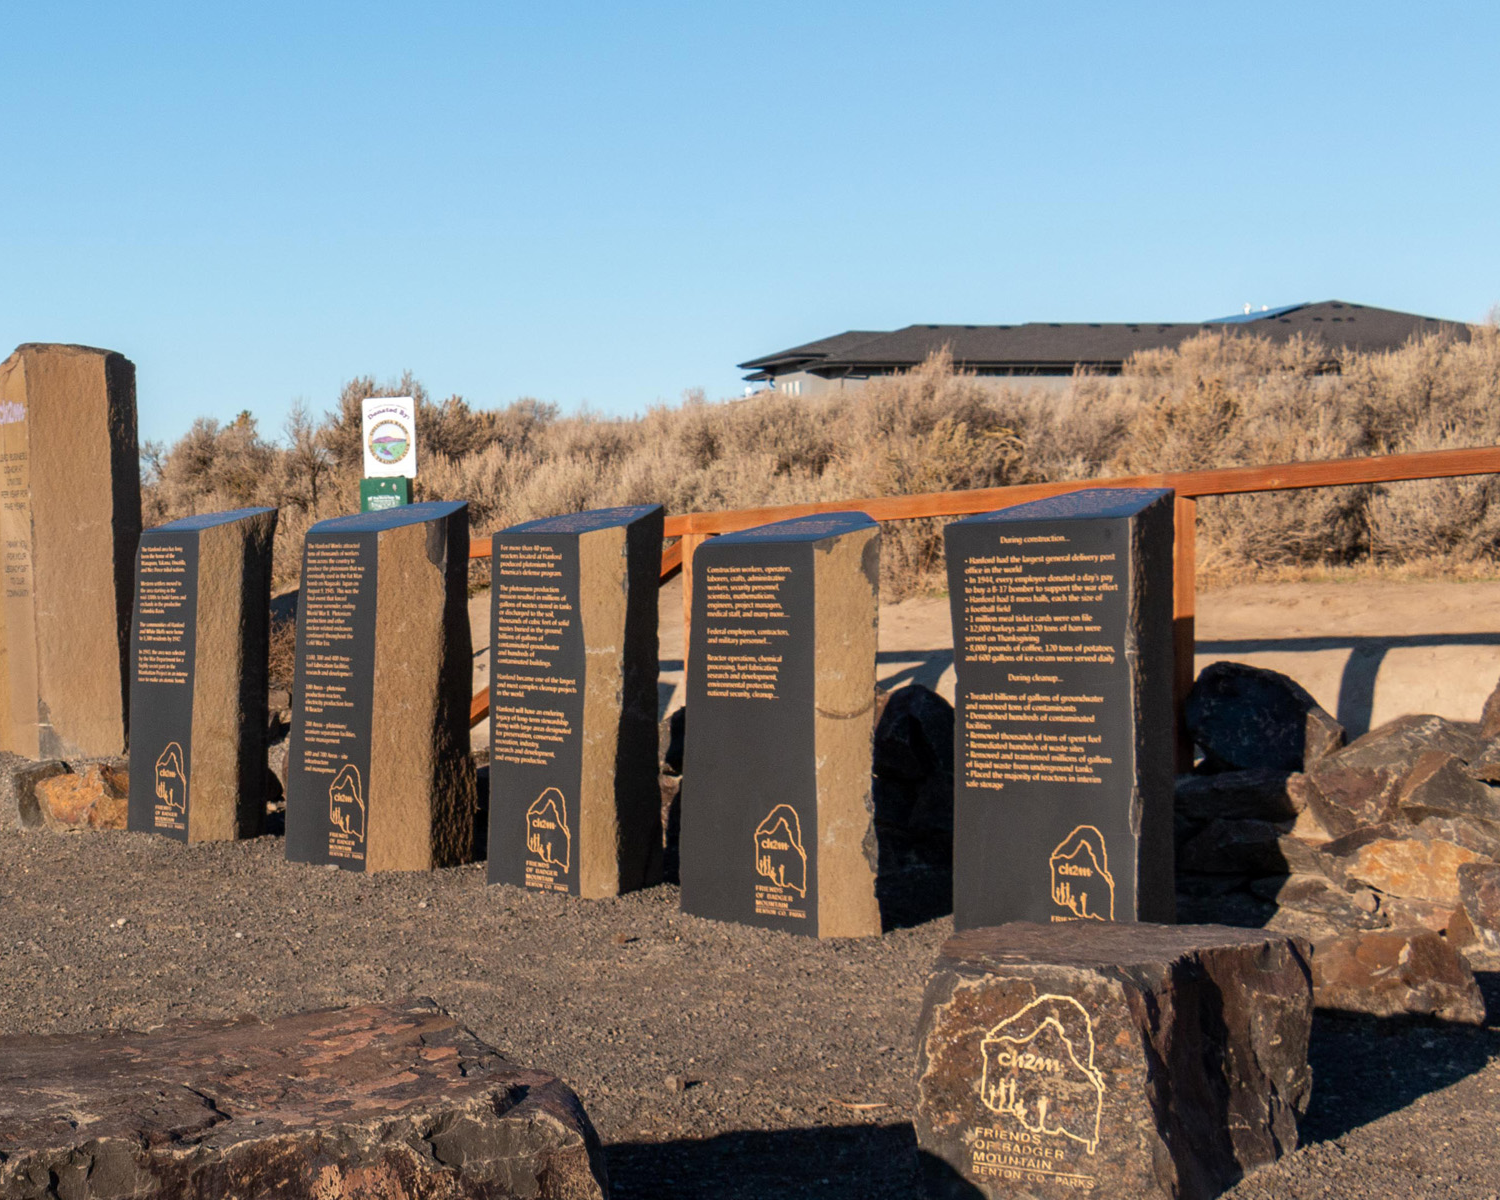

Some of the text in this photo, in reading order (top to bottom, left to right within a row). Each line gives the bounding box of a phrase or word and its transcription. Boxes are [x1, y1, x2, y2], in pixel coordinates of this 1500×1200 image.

[368, 408, 398, 419] Donated
[1000, 536, 1022, 544] During
[1021, 555, 1044, 564] largest
[1045, 554, 1070, 563] general
[1071, 553, 1098, 562] delivery
[1099, 553, 1115, 561] post
[1014, 575, 1046, 583] employee
[1082, 573, 1099, 582] day's
[973, 585, 985, 595] buy
[992, 625, 1015, 633] turkeys
[997, 634, 1039, 643] Thanksgiving
[988, 644, 1012, 652] pounds
[992, 654, 1014, 662] gallons
[1097, 654, 1114, 663] daily
[1007, 673, 1030, 682] During
[526, 860, 550, 869] FRIENDS
[535, 868, 558, 877] BADGER
[526, 874, 554, 882] MOUNTAIN
[755, 884, 783, 894] FRIENDS
[767, 894, 793, 902] BADGER
[755, 900, 788, 909] MOUNTAIN
[974, 1127, 1041, 1145] FRIENDS
[974, 1139, 1064, 1160] OF BADGER
[973, 1152, 1053, 1171] MOUNTAIN
[972, 1165, 1095, 1190] BENTON CO. PARKS
